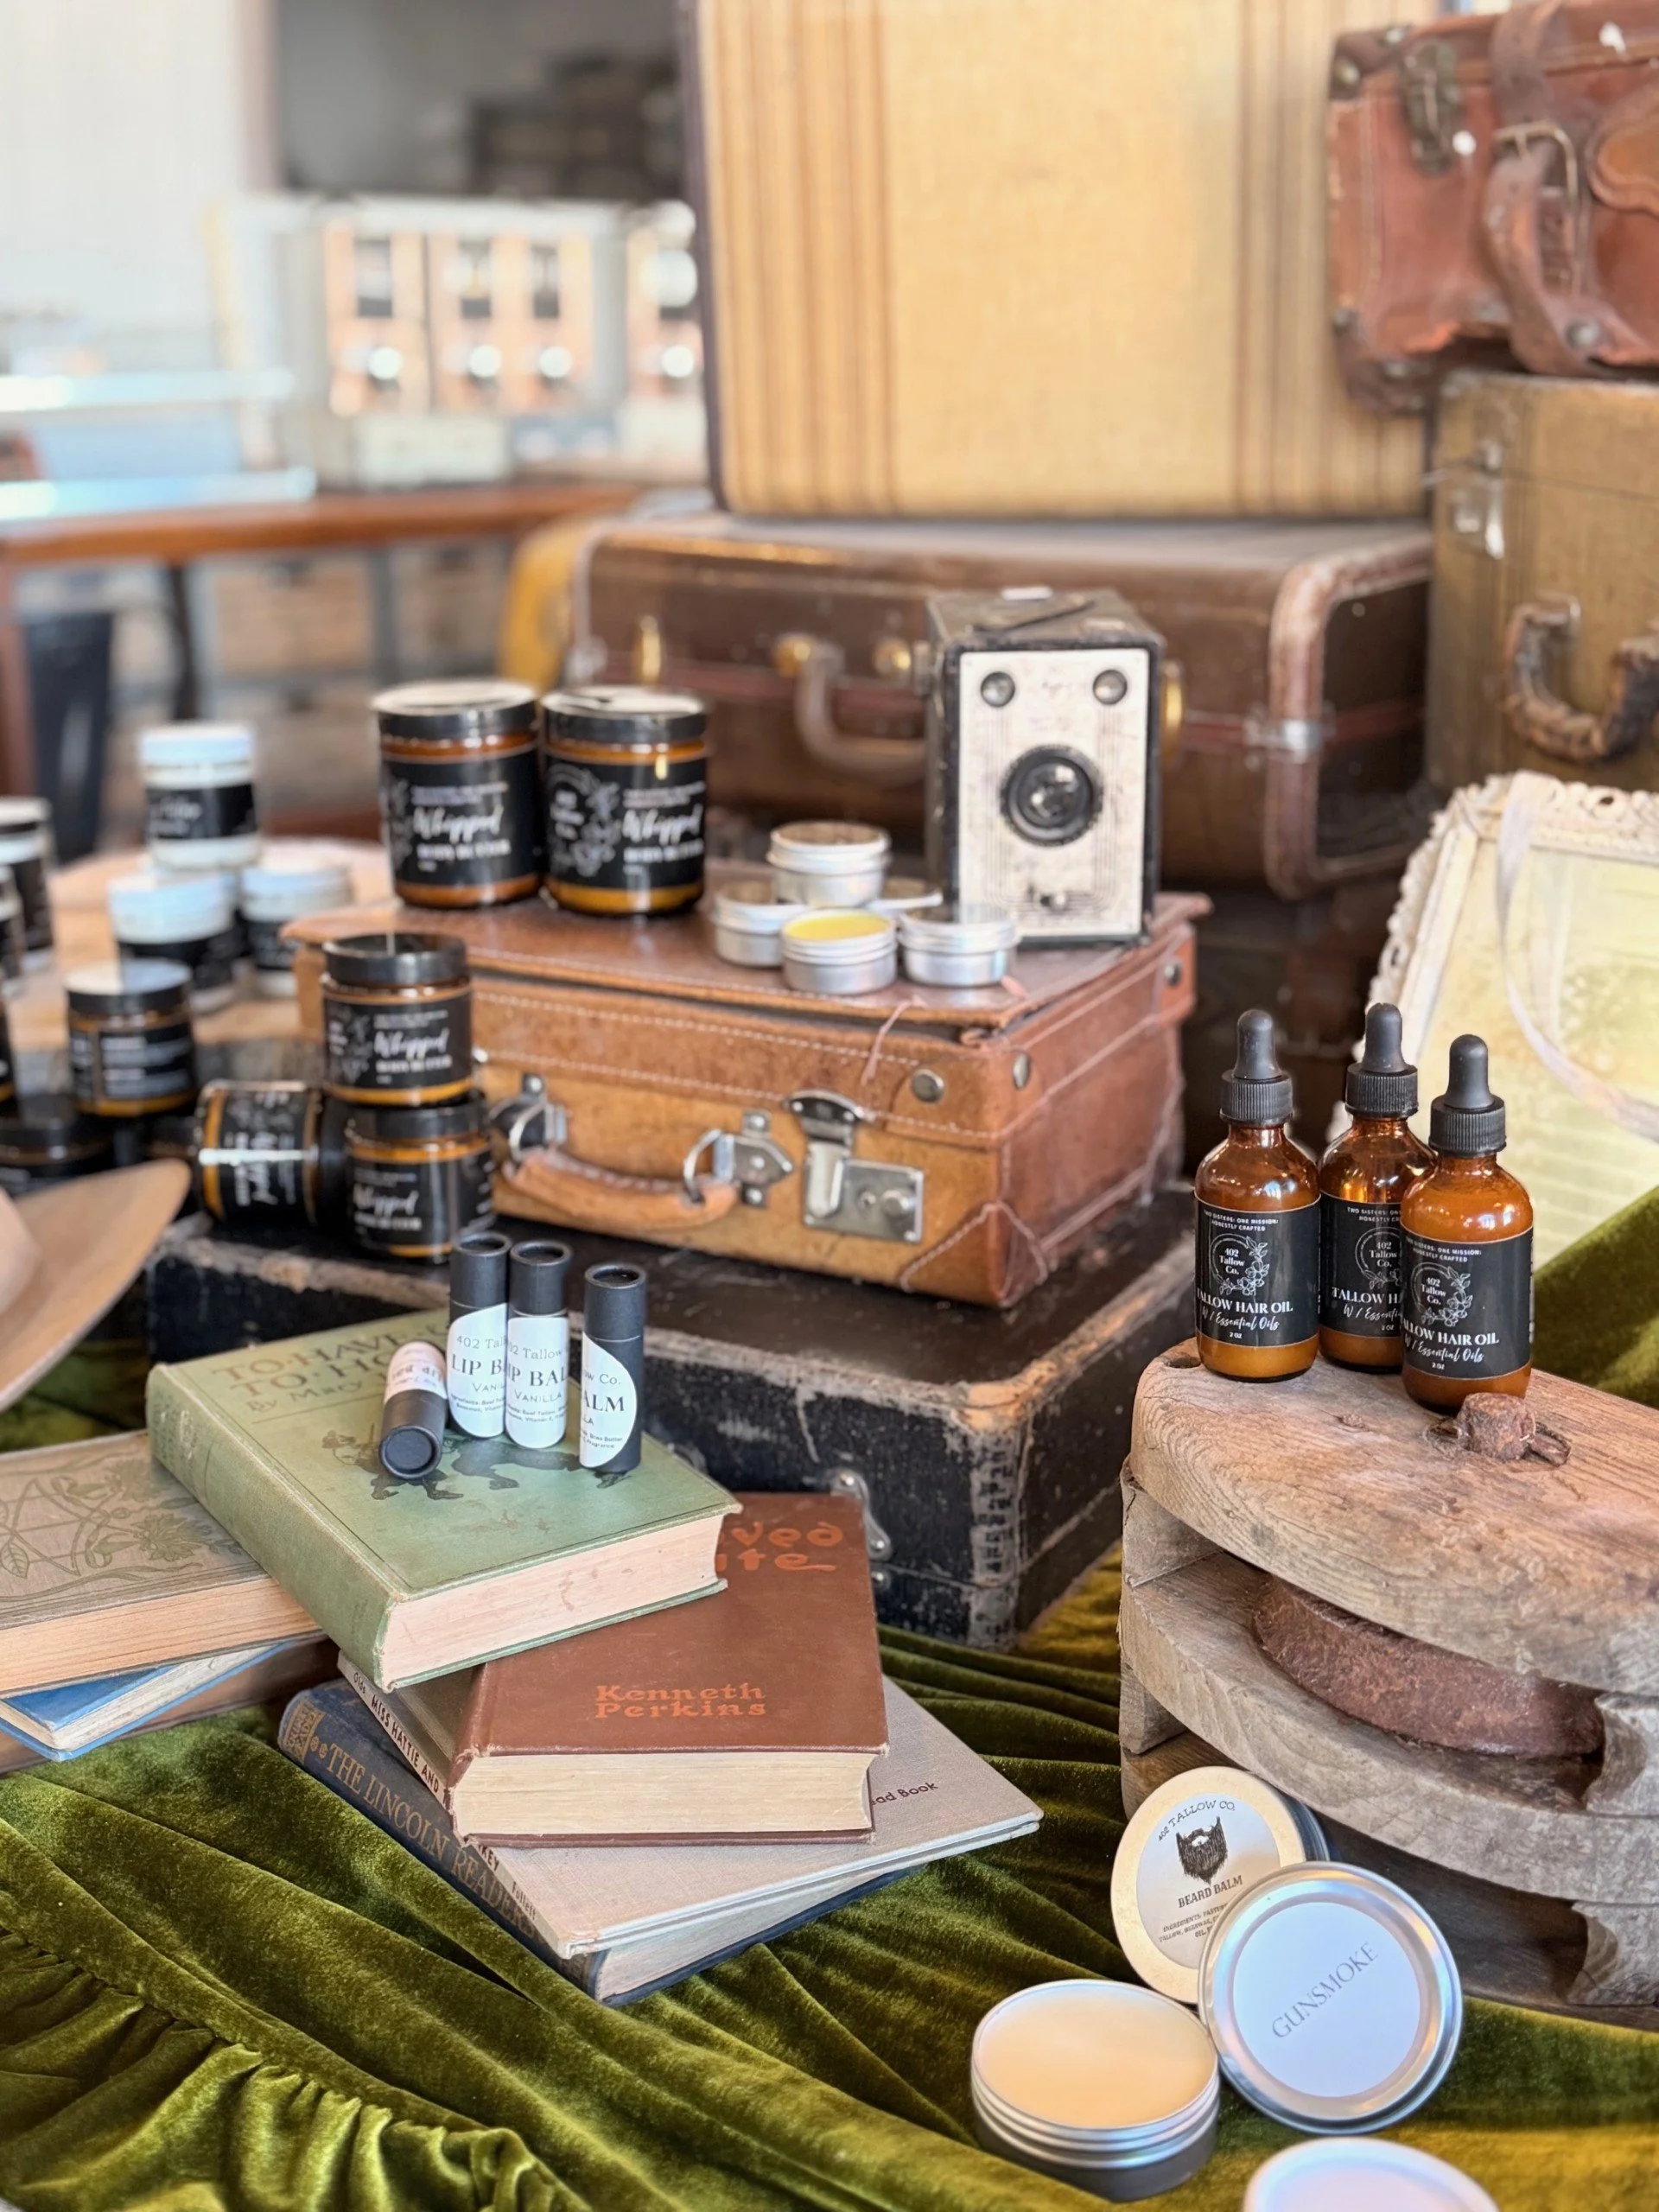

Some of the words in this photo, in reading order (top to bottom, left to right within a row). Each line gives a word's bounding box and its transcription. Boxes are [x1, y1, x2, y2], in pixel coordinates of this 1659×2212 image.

[1224, 1247, 1240, 1258] 402
[1369, 1249, 1397, 1259] Tallow
[1376, 1241, 1392, 1250] 402
[1219, 1255, 1245, 1268] Tallow
[1225, 1265, 1240, 1275] Co.
[1376, 1258, 1393, 1268] Co.
[1421, 1284, 1446, 1297] Tallow
[1427, 1277, 1441, 1287] 402
[1332, 1286, 1384, 1305] TALLOW
[1427, 1295, 1442, 1306] Co.
[1236, 1300, 1269, 1314] HAIR
[1271, 1300, 1294, 1313] OIL
[1215, 1311, 1257, 1331] Essential
[1259, 1315, 1281, 1332] Oils
[456, 1335, 480, 1349] 402
[1438, 1331, 1473, 1346] HAIR
[1475, 1332, 1500, 1346] OIL
[508, 1341, 519, 1356] 02
[523, 1346, 562, 1361] Tallow
[1418, 1340, 1460, 1362] Essential
[1462, 1347, 1484, 1363] Oils
[451, 1353, 482, 1376] LIP
[508, 1362, 521, 1382] IP
[530, 1367, 567, 1387] BAL
[599, 1372, 620, 1385] Co.
[230, 1372, 308, 1398] TO
[513, 1389, 562, 1403] VANILLA
[719, 1520, 843, 1548] ved
[595, 1681, 766, 1703] Kenneth
[594, 1700, 766, 1719] Perkins
[372, 1694, 391, 1728] MISS
[391, 1721, 420, 1768] HATTIE
[422, 1764, 440, 1794] AND
[897, 1782, 939, 1798] Book
[327, 1743, 366, 1796] THE
[363, 1774, 451, 1861] LINCOLN
[1158, 1826, 1170, 1842] 402
[1168, 1800, 1217, 1827] TALLOW
[1219, 1800, 1236, 1812] CO.
[1178, 1886, 1212, 1909] BEARD
[1213, 1874, 1243, 1895] BALM
[1271, 1941, 1380, 2038] GUNSMOKE
